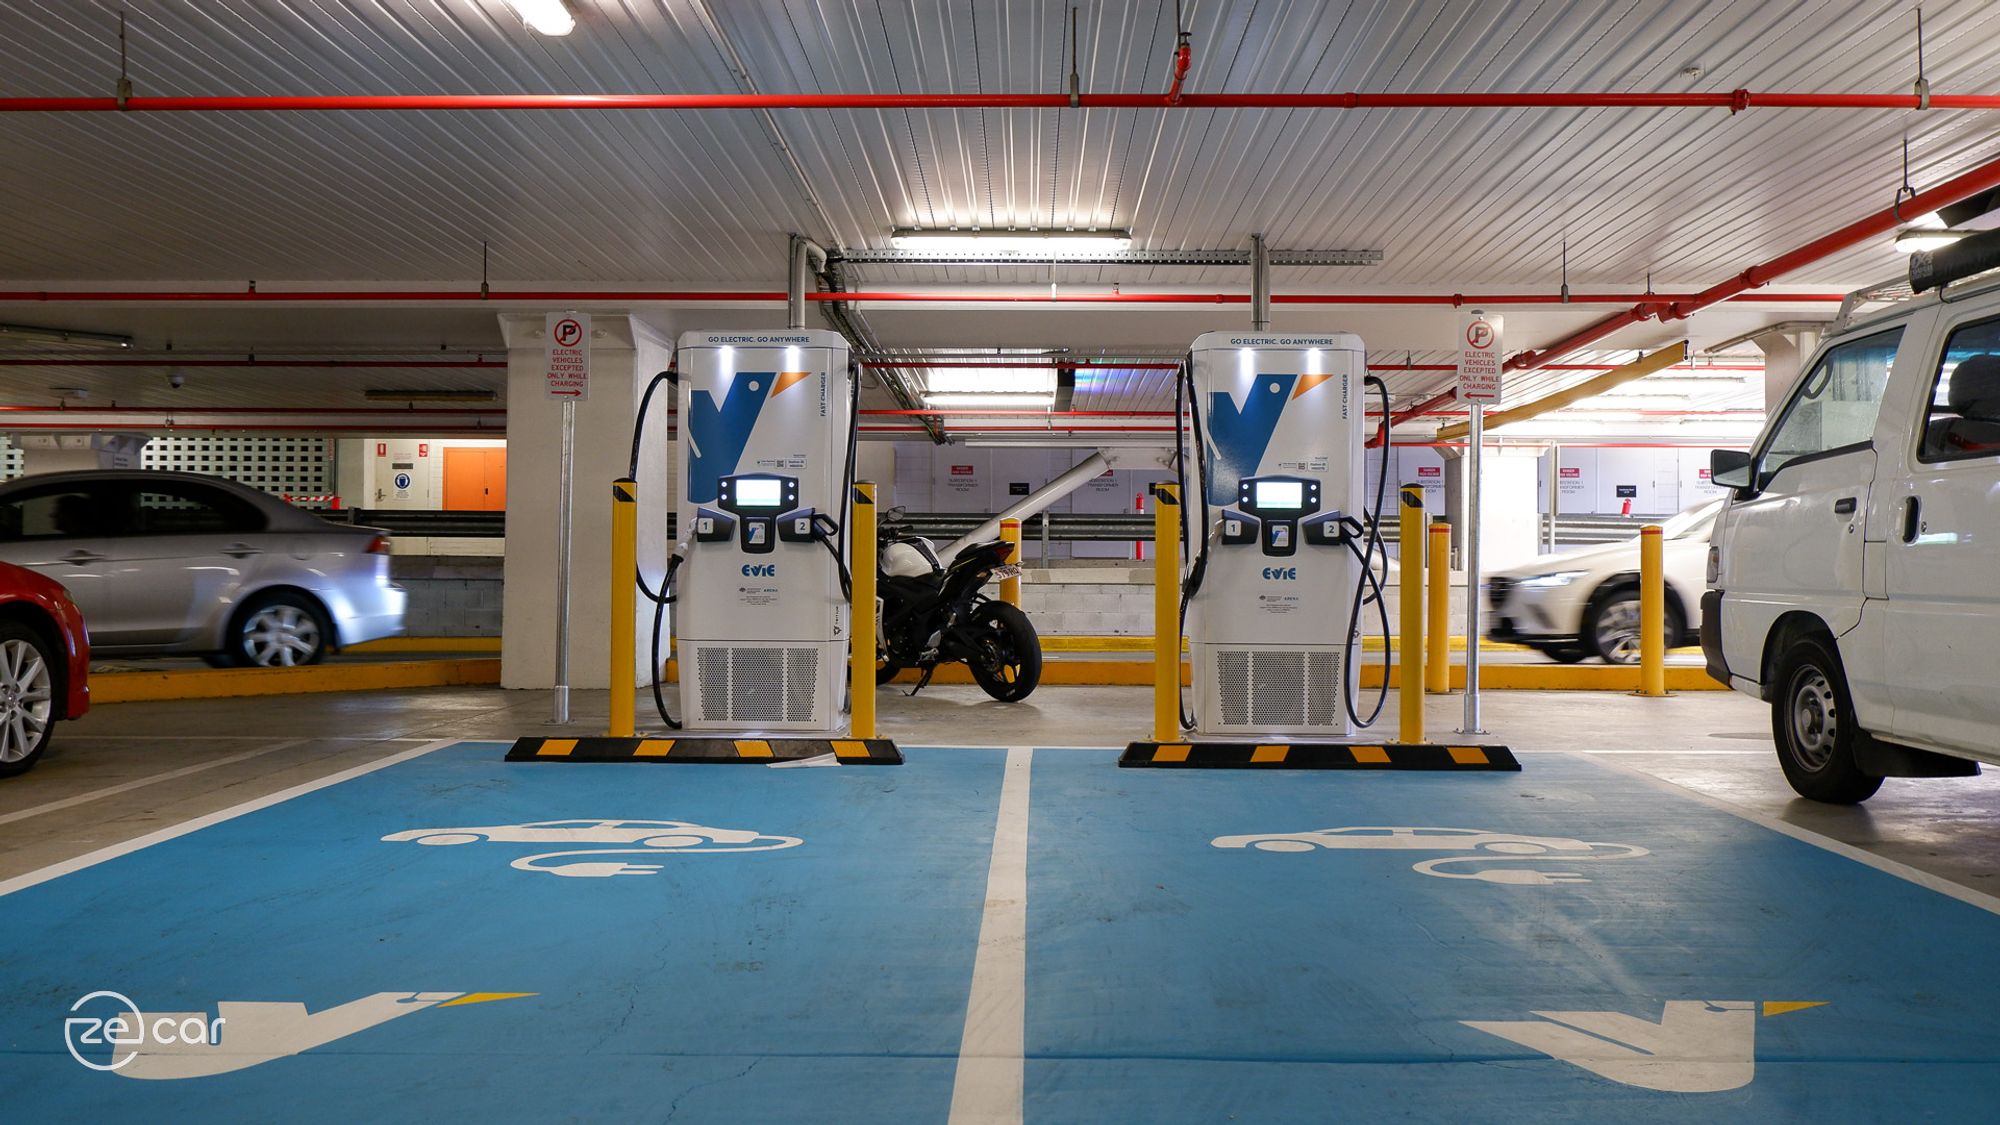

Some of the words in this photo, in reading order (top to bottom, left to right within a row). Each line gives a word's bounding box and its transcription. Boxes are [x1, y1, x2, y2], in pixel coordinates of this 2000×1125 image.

[702, 522, 708, 530] 1
[800, 522, 806, 531] 2
[1230, 524, 1236, 532] 1
[1328, 525, 1335, 533] 2
